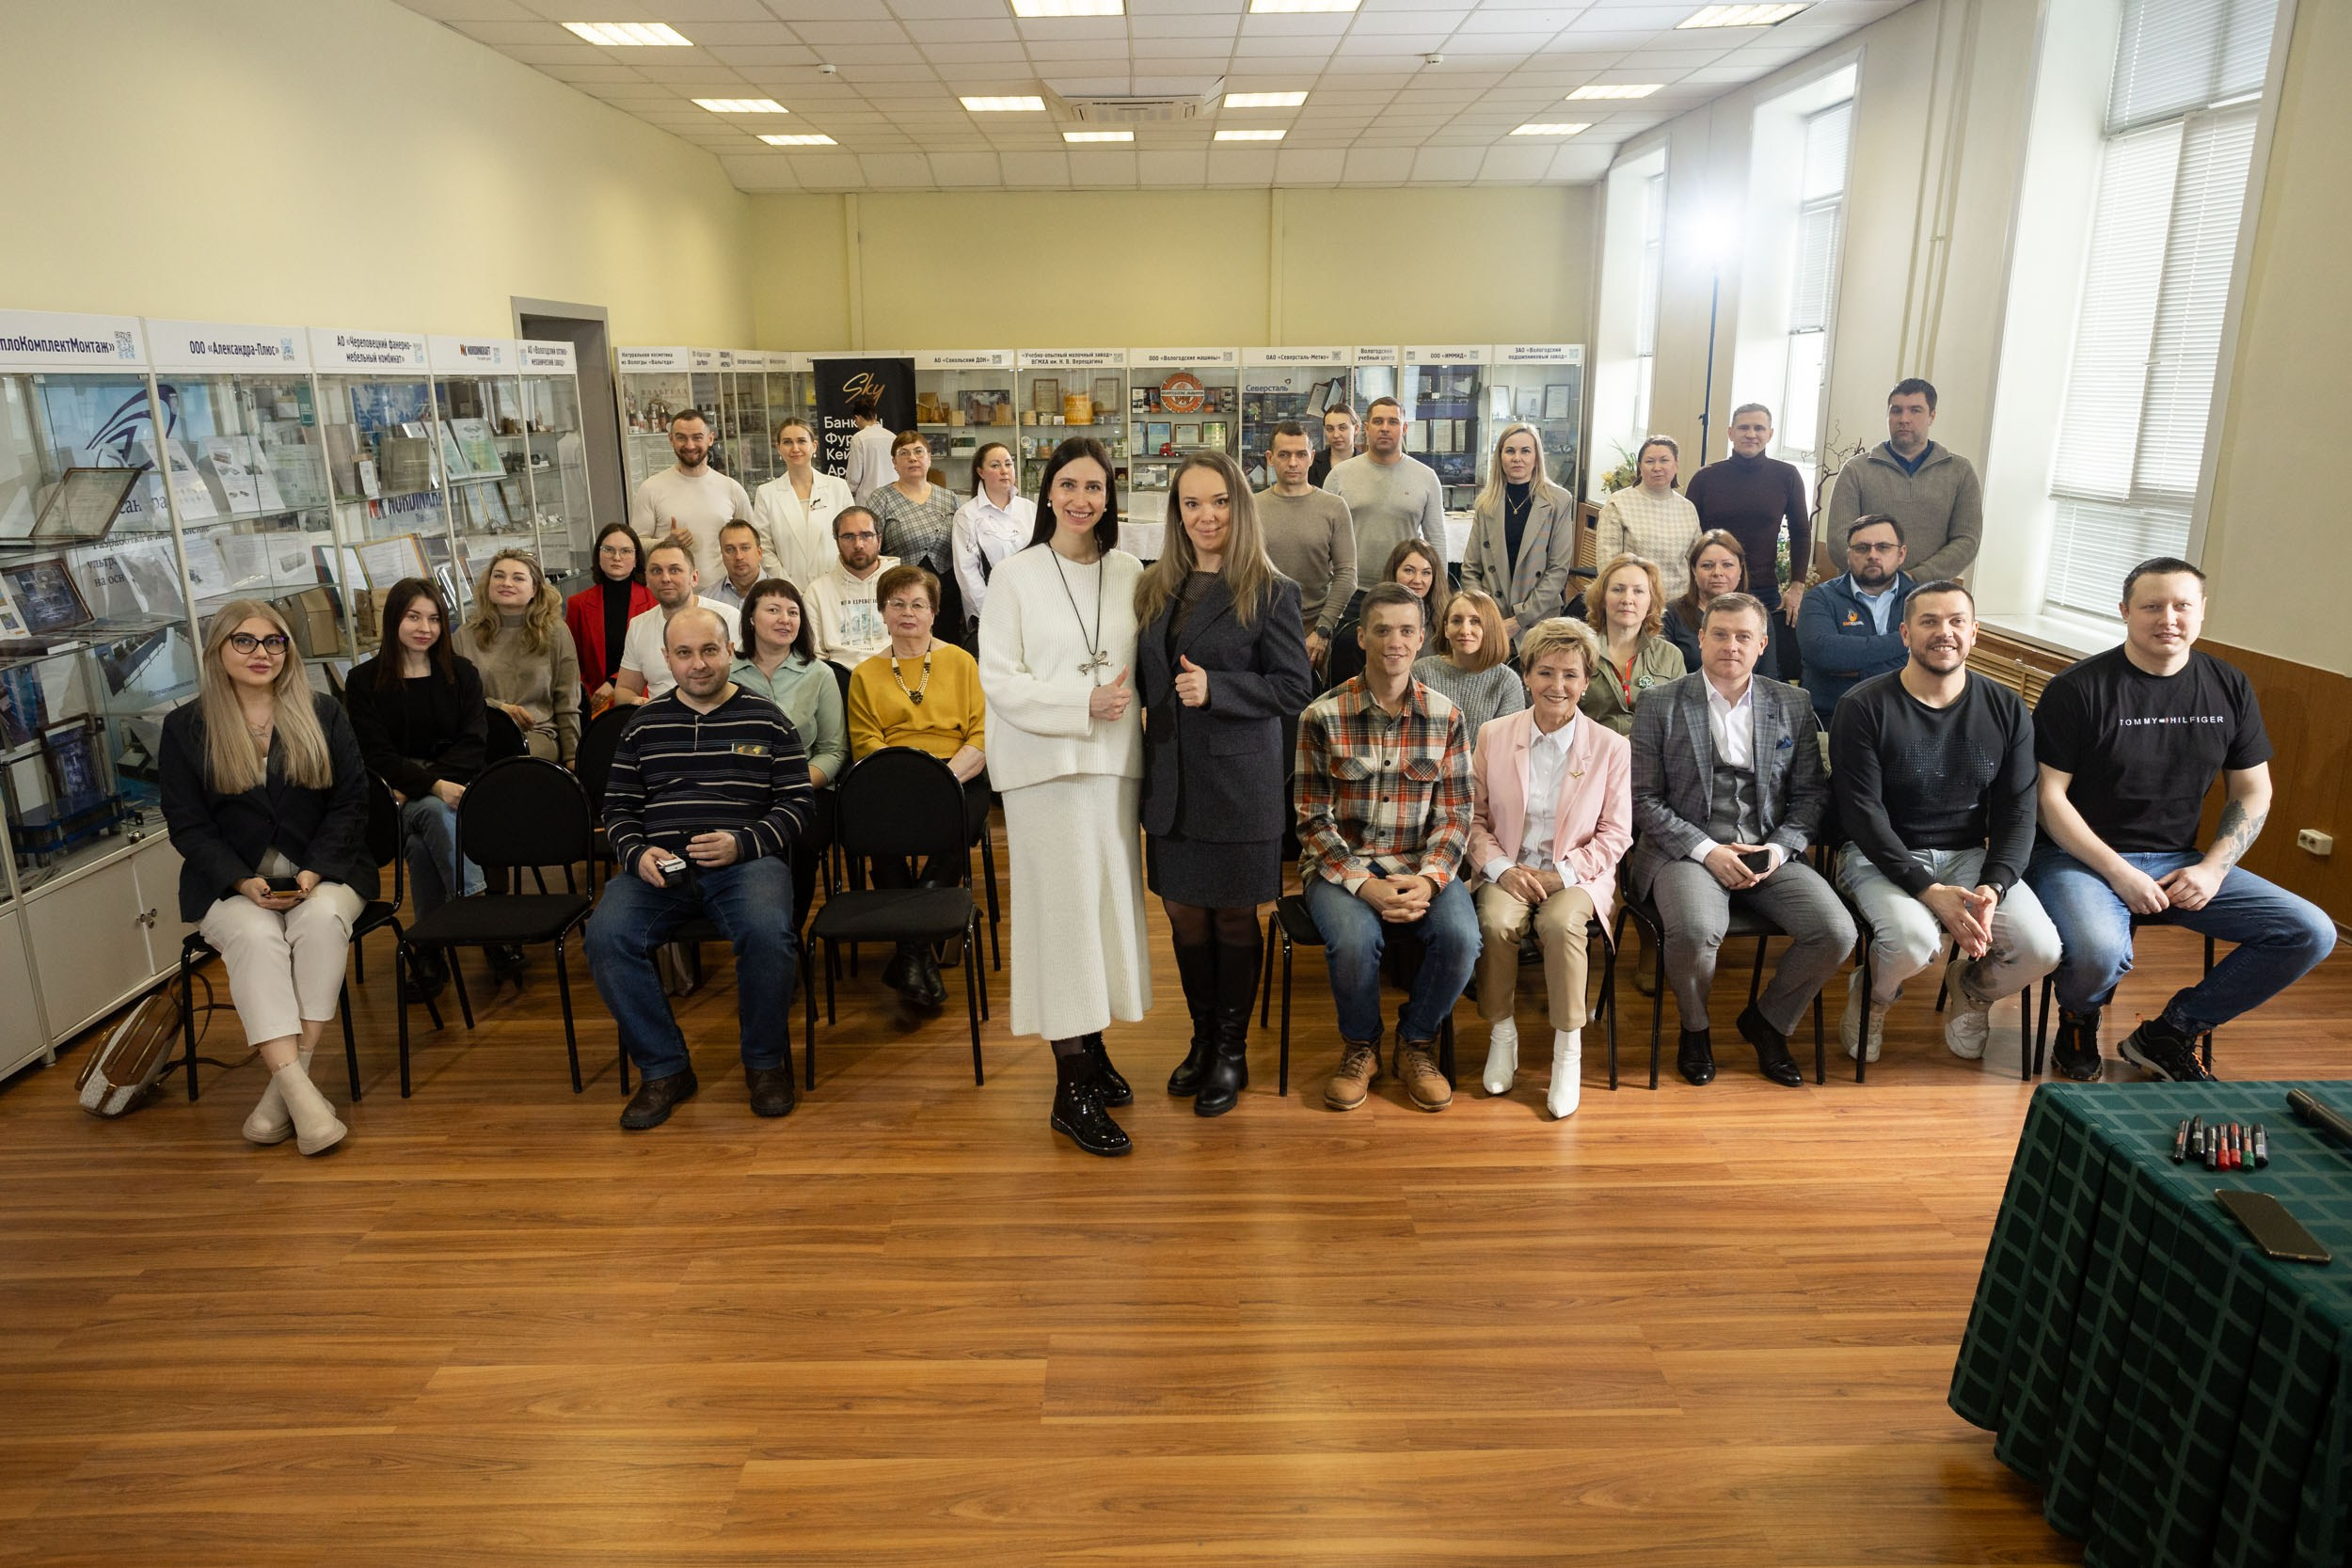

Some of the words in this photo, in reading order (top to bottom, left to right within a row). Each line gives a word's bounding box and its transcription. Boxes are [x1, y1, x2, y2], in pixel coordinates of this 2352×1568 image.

[0, 336, 115, 353] плоКомплектМонтаж»
[337, 335, 345, 346] АО
[189, 341, 206, 354] ООО
[207, 341, 279, 357] «Александра-Плюс»
[842, 372, 885, 406] Sky
[1246, 385, 1289, 393] Северсталь
[825, 433, 853, 447] Фур
[826, 448, 850, 461] Кей
[828, 464, 847, 478] Ар
[108, 574, 125, 585] осн
[2119, 717, 2158, 726] TOMMY
[2169, 716, 2224, 724] HILFIGER
